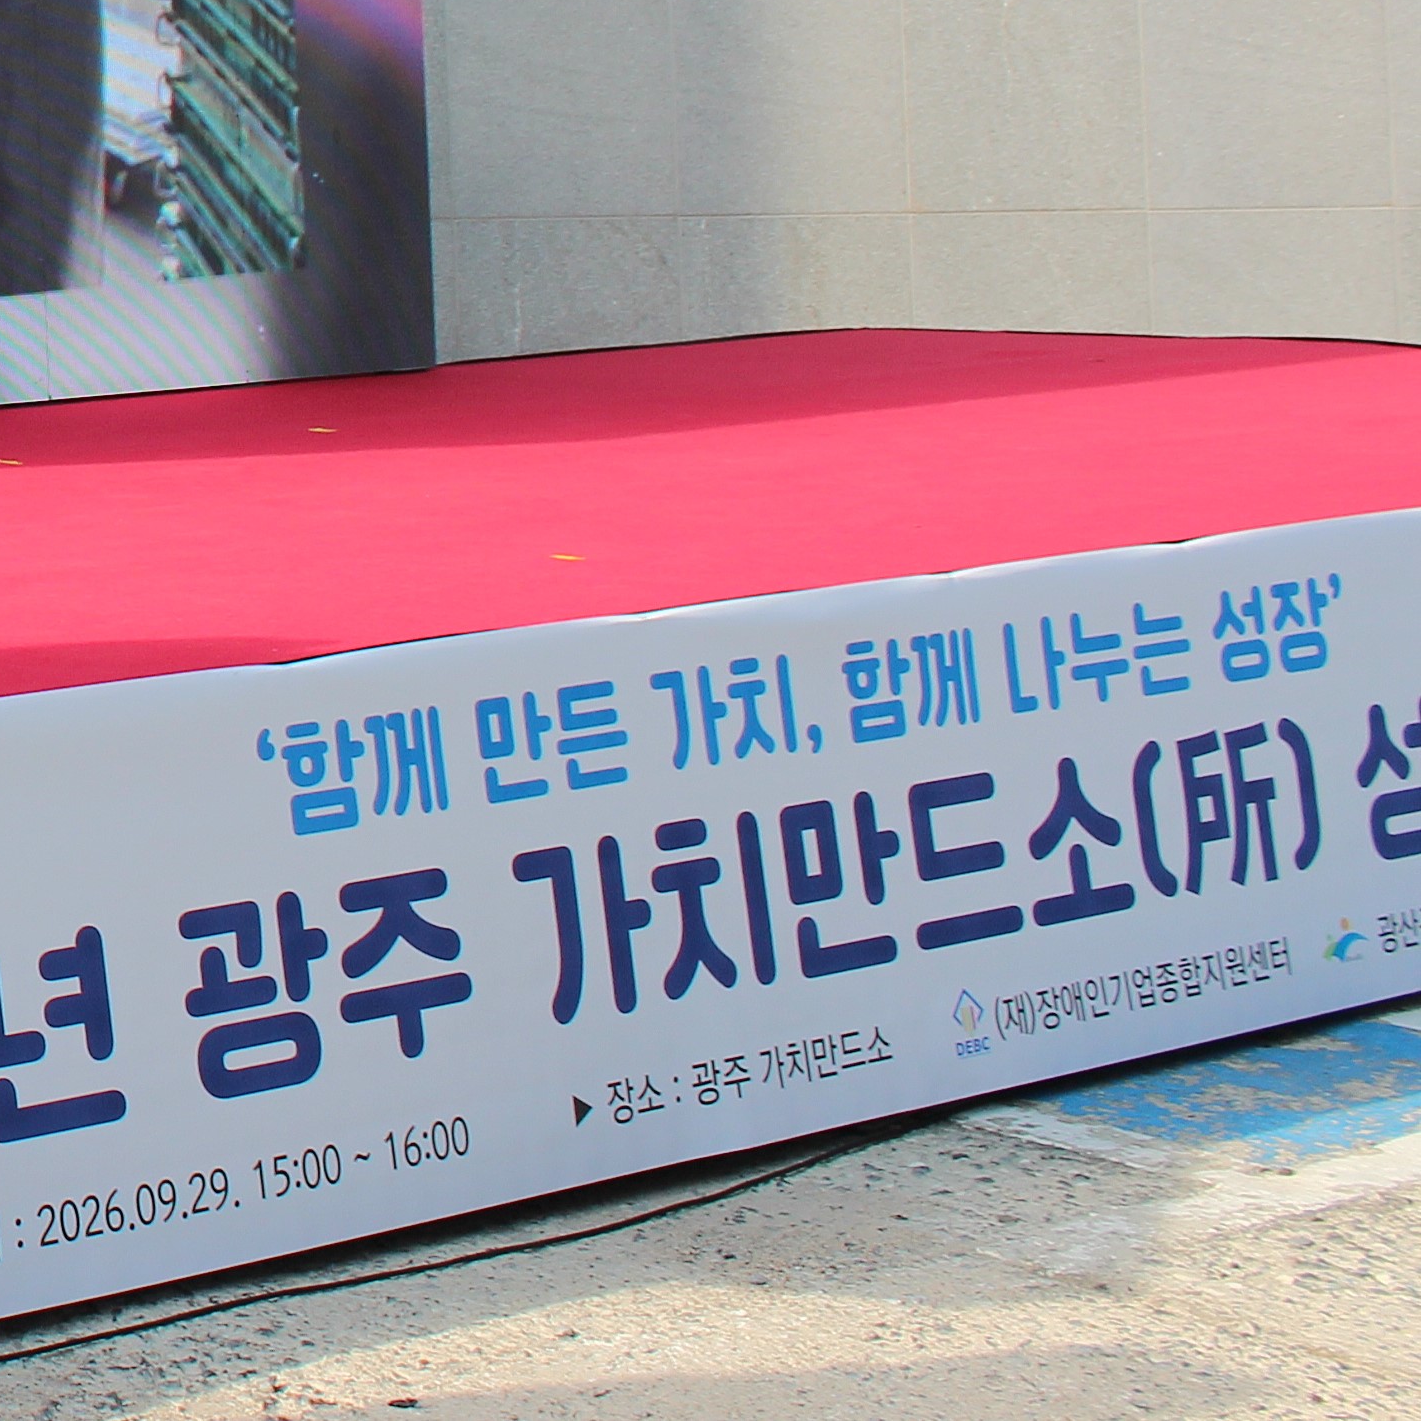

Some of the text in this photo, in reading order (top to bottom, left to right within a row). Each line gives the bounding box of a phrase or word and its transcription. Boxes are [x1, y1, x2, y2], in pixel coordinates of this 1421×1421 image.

[473, 679, 630, 804] 만든
[650, 653, 825, 771] 가치,
[840, 627, 982, 744] 함께
[1001, 601, 1193, 715] 나누는
[1210, 571, 1345, 683] 성장’
[177, 867, 474, 1101] 광주
[511, 717, 1323, 1026] 가치만드소(所)
[1375, 906, 1421, 955] 광산
[993, 935, 1295, 1041] (재)장애인기업종합지원센터
[606, 1068, 667, 1127] 장소
[690, 1053, 754, 1112] 광주
[759, 1027, 895, 1091] 가치만드소
[955, 1036, 991, 1058] DEBC
[37, 1167, 242, 1247] 2026.09.29.
[253, 1141, 343, 1203] 15:00
[385, 1115, 472, 1178] 16:00
